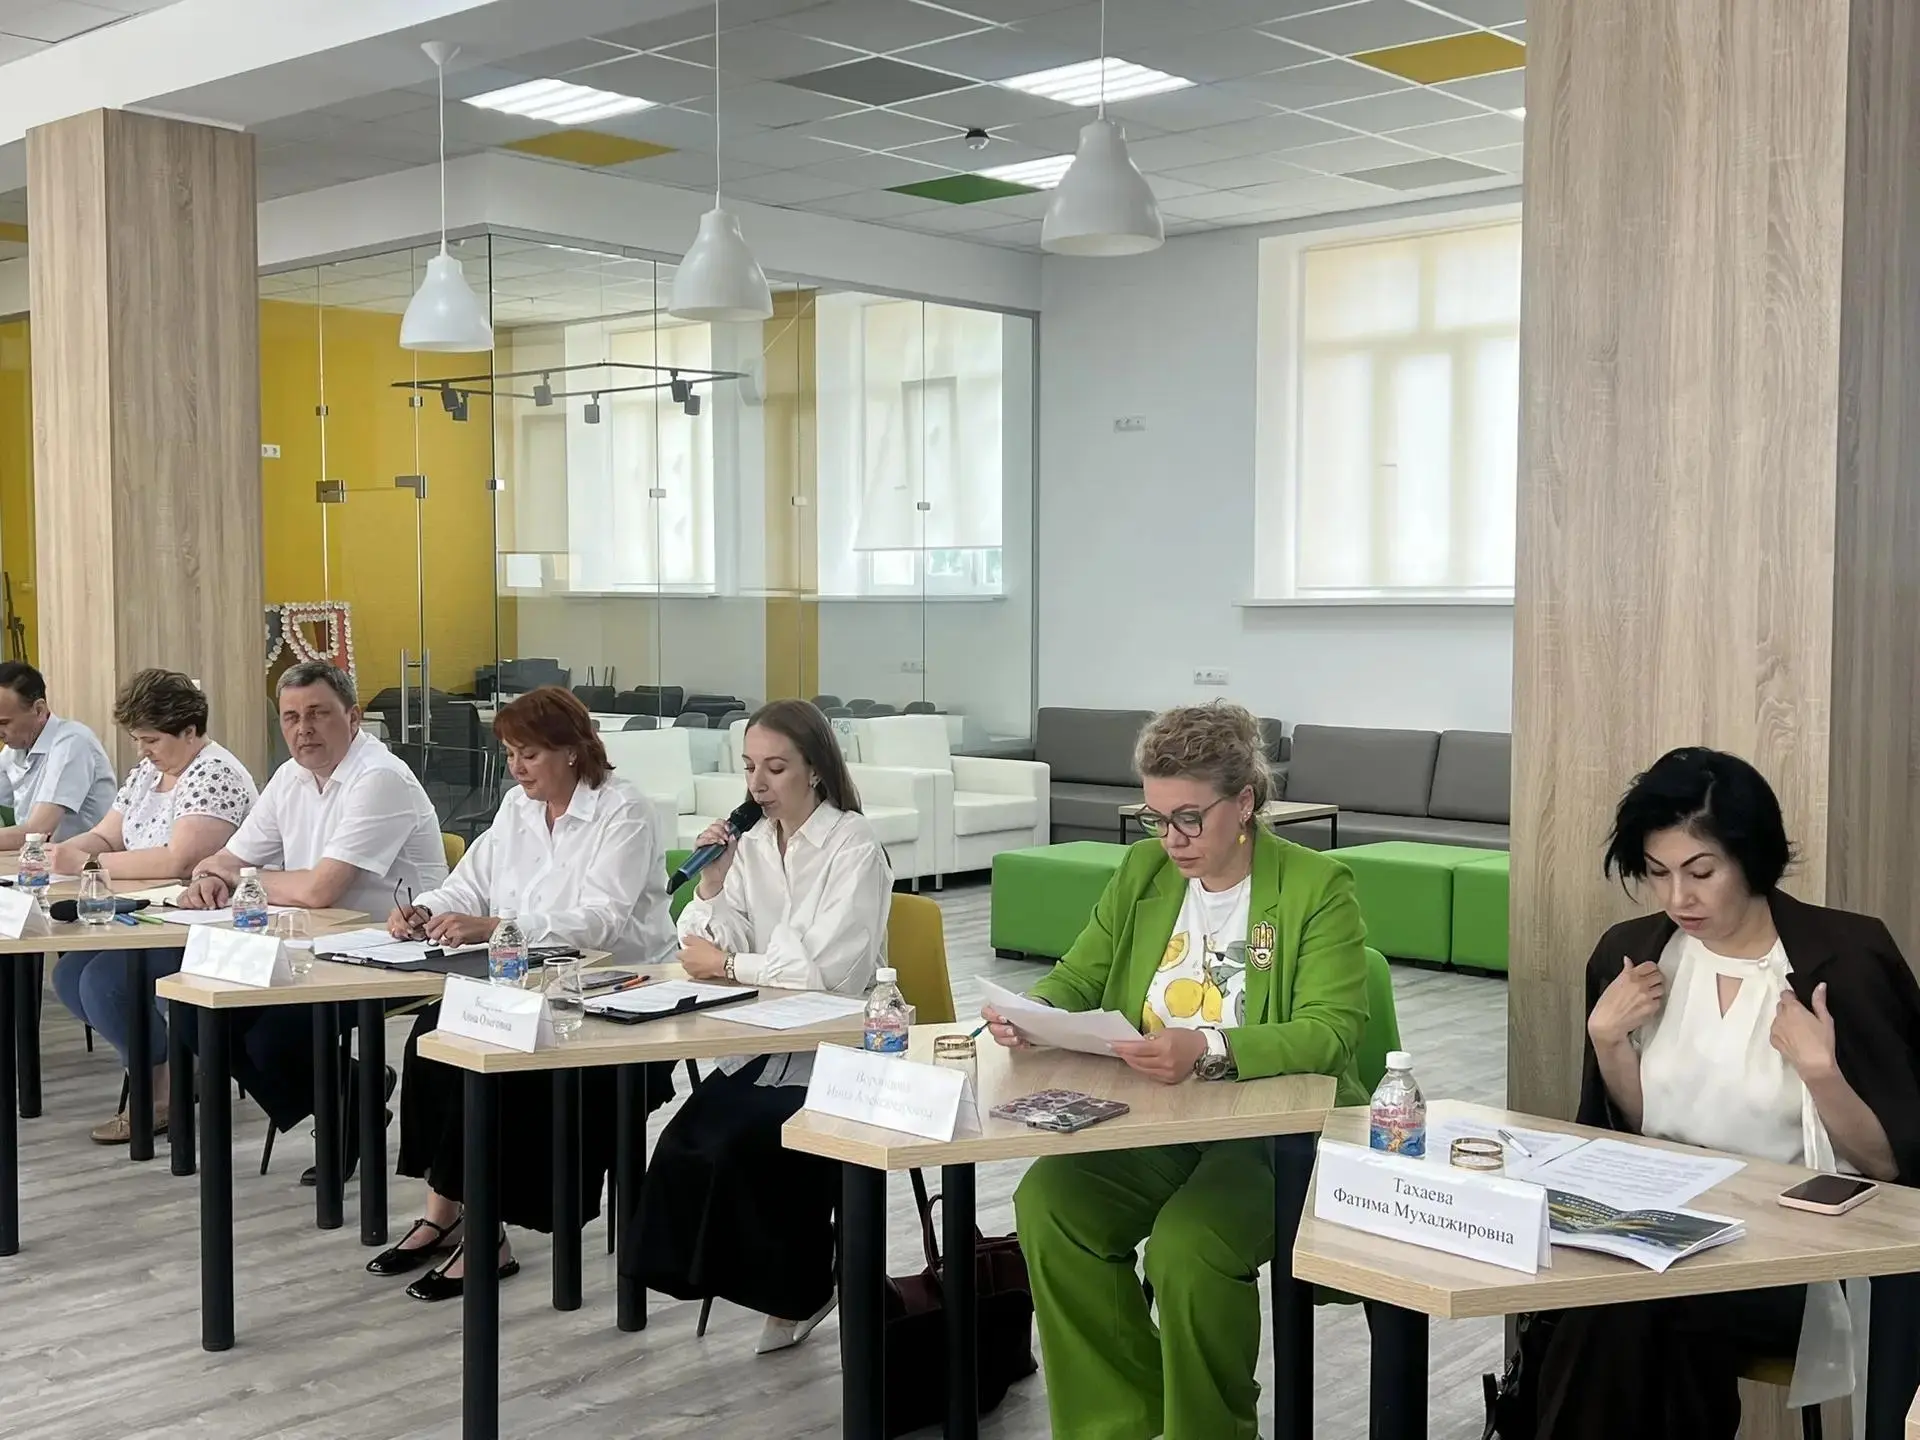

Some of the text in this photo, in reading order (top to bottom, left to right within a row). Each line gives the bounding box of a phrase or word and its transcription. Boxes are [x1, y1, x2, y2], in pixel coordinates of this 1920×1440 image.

[1392, 1177, 1454, 1206] Тахаева
[1332, 1186, 1389, 1214] Фатима
[1393, 1201, 1514, 1245] Мухаджировна
